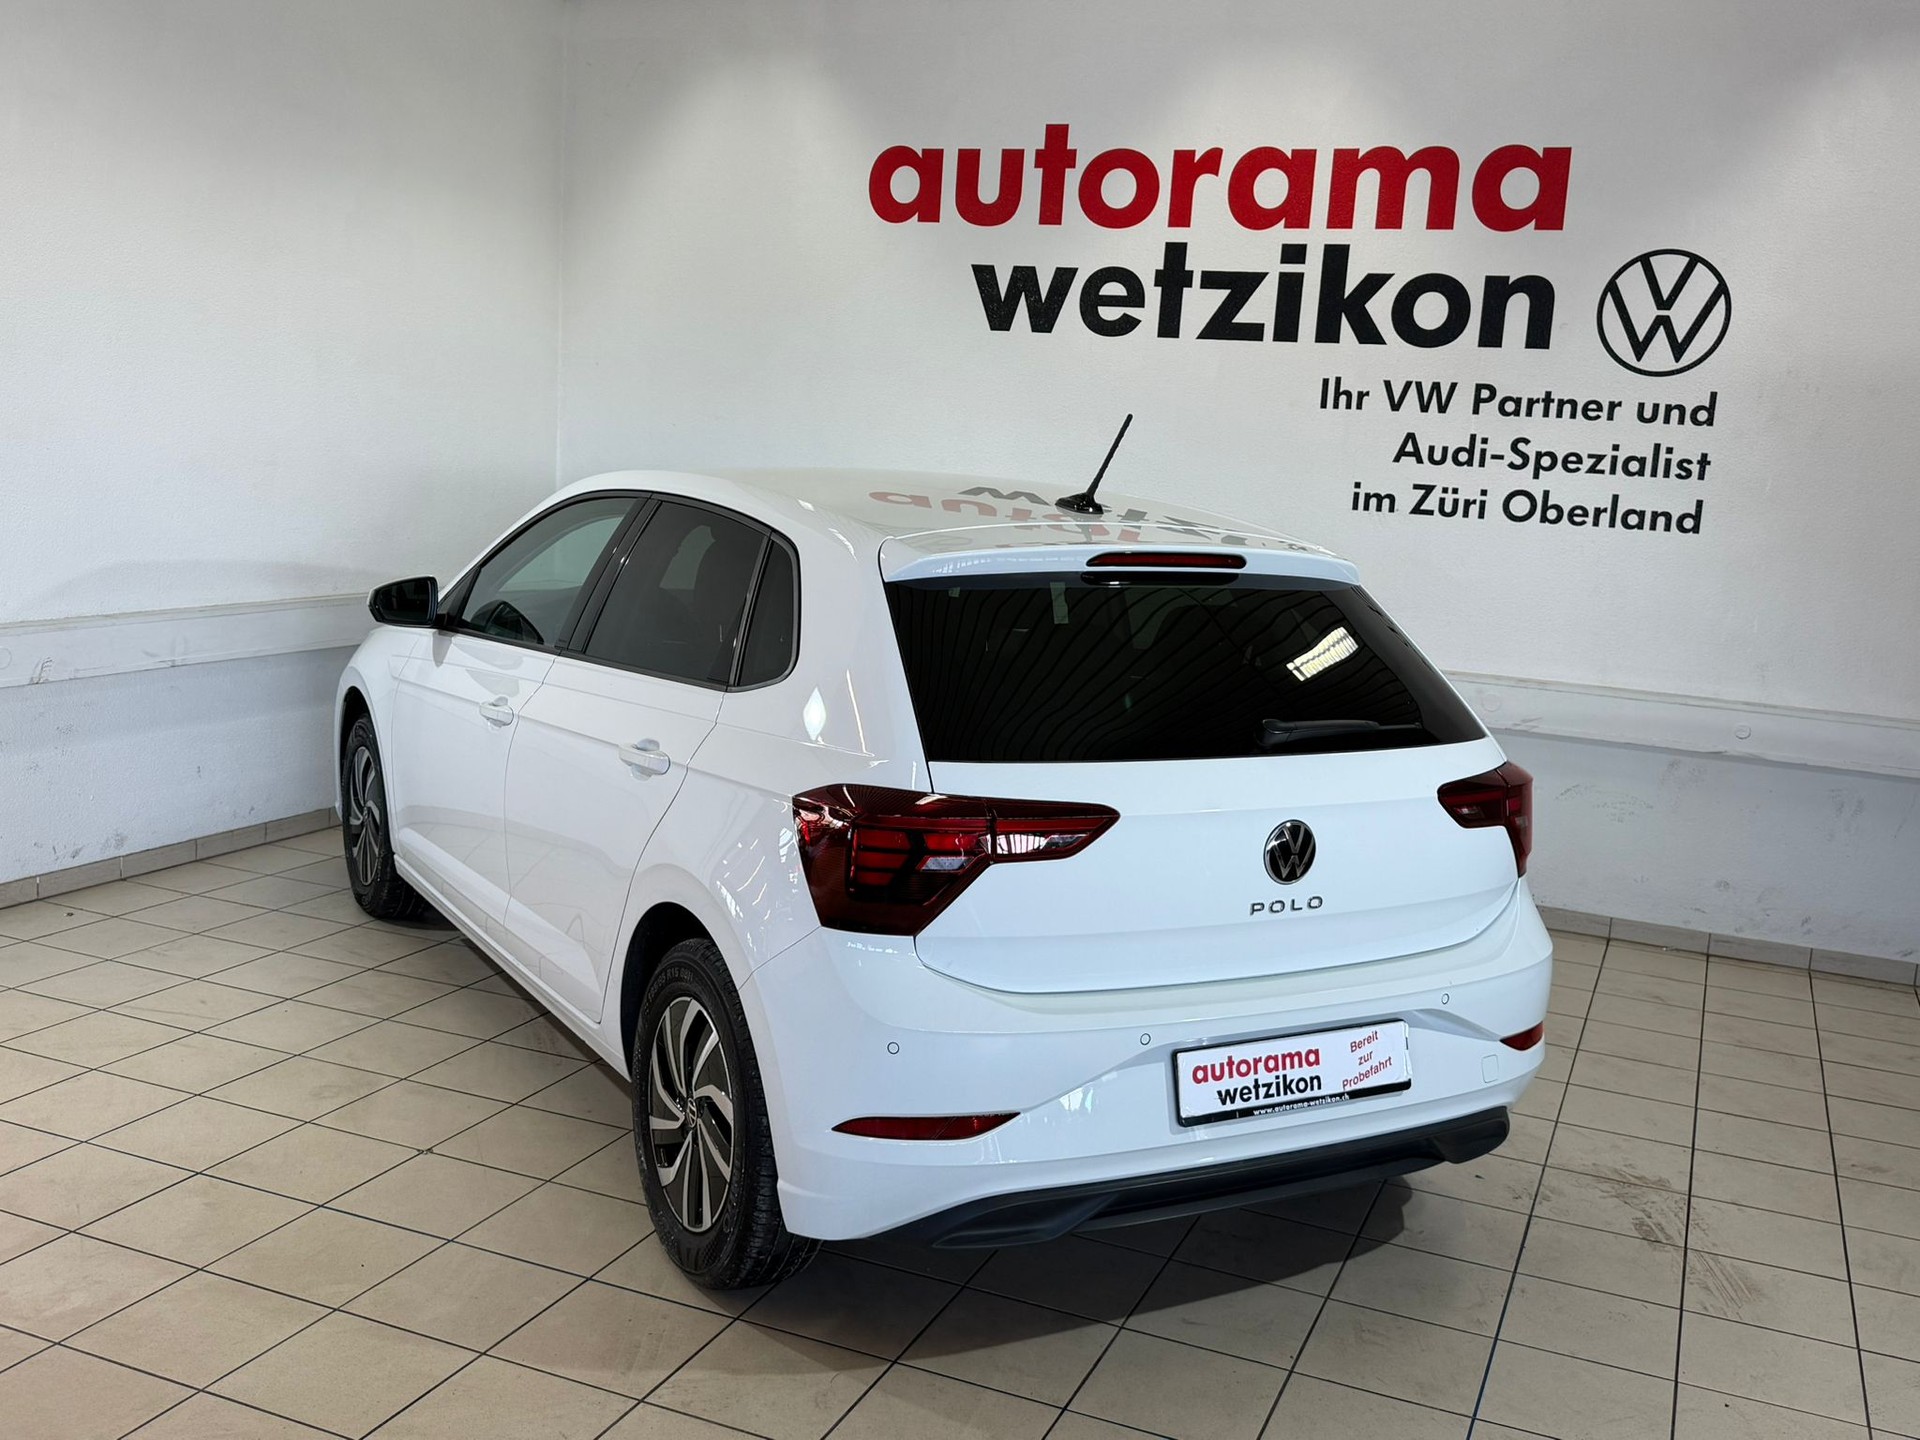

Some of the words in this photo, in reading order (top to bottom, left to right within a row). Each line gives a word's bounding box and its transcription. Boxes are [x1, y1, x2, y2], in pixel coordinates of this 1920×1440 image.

[869, 124, 1573, 232] autorama
[971, 241, 1556, 350] wetzikon
[1319, 376, 1370, 411] Ihr
[1384, 379, 1459, 414] VW
[1471, 382, 1623, 422] Partner
[1636, 391, 1718, 427] und
[1392, 431, 1712, 481] Audi-Spezialist
[1351, 481, 1396, 514] im
[1408, 483, 1489, 520] Züri
[1502, 488, 1704, 535] Oberland
[1250, 896, 1323, 915] POLO
[1350, 1030, 1379, 1053] Bereit
[1358, 1050, 1373, 1066] zur
[1192, 1048, 1320, 1085] autorama
[1342, 1055, 1392, 1092] Probefahrt
[1216, 1074, 1322, 1106] wetzikon
[1253, 1093, 1350, 1116] www.autorama-wetzikon.ch
